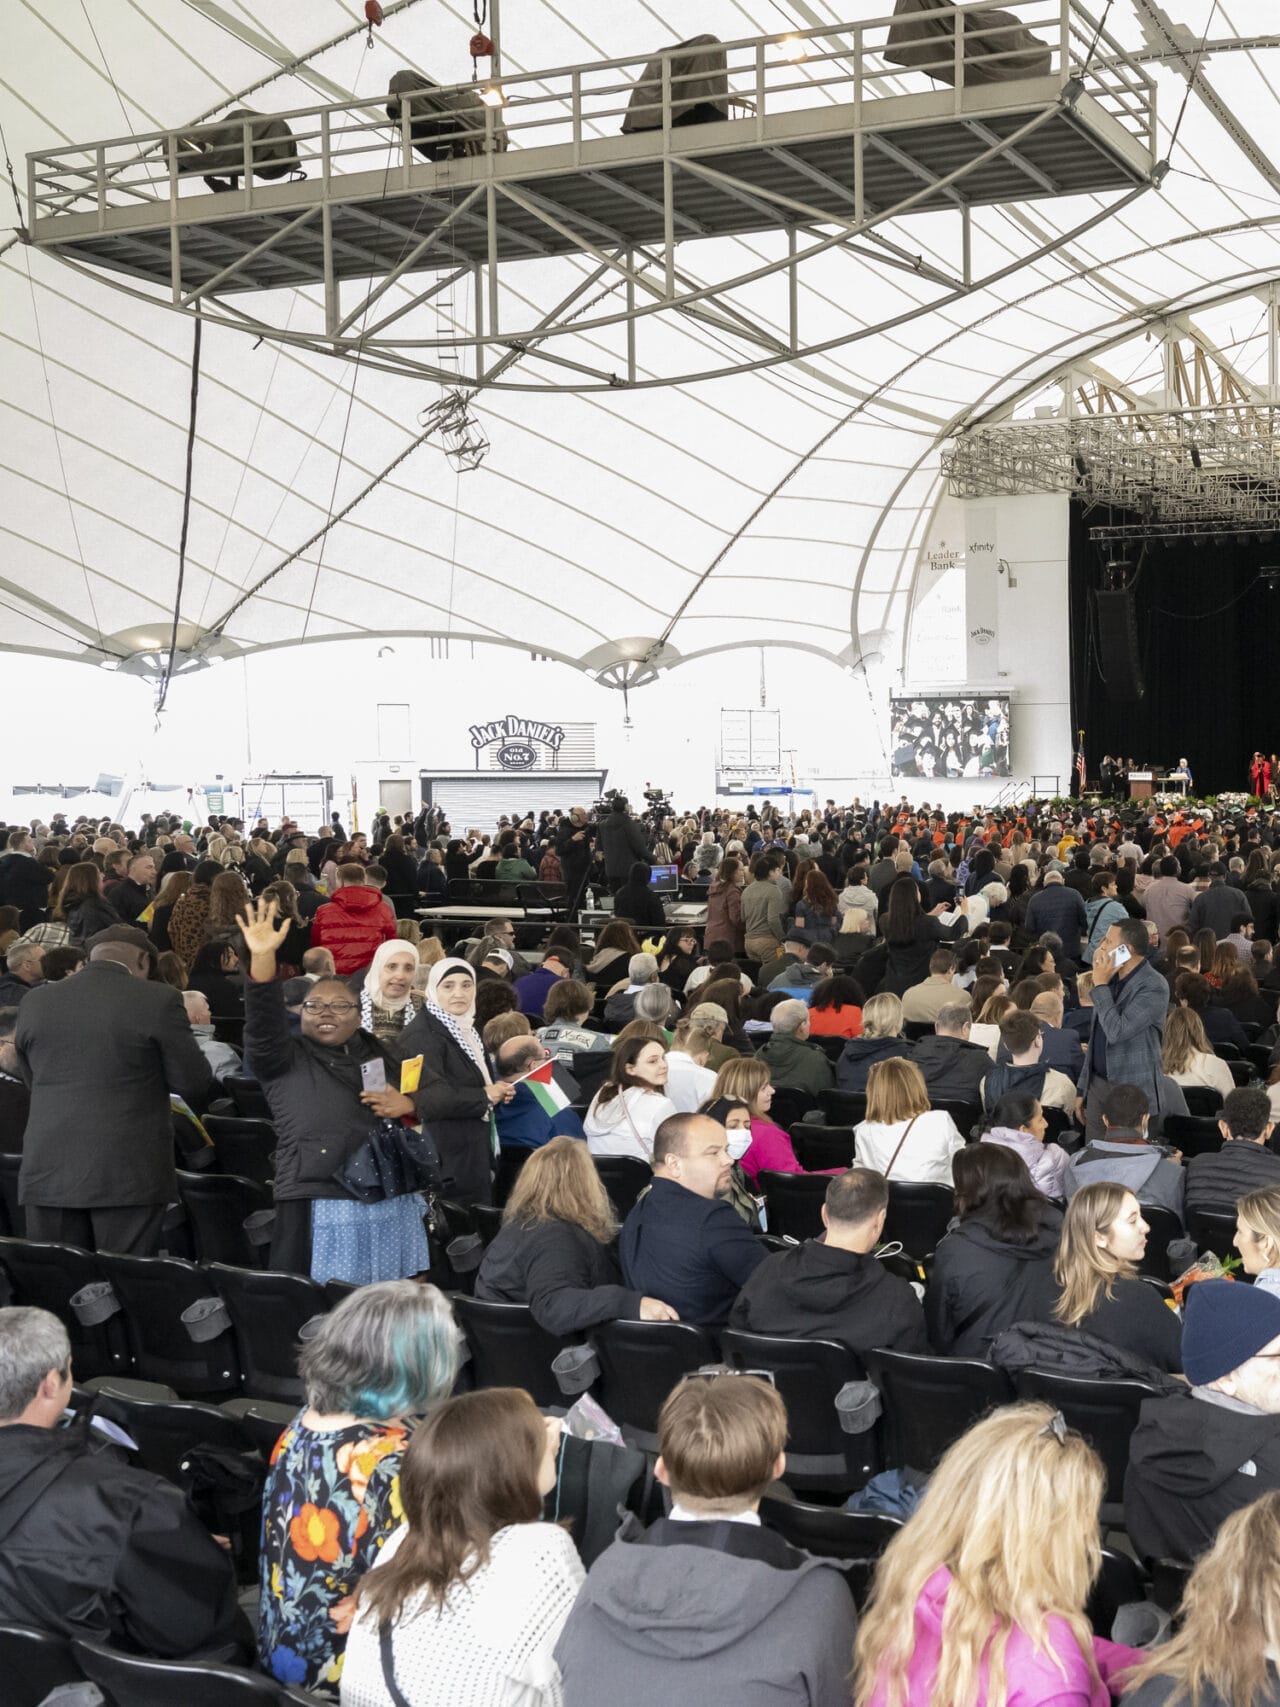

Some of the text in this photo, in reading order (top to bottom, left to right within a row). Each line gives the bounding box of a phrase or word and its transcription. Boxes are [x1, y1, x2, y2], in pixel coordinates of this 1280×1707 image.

[968, 542, 995, 553] xfinity
[927, 550, 960, 560] Leader
[930, 561, 956, 571] Bank
[469, 716, 565, 750] JACK DANIEL'S
